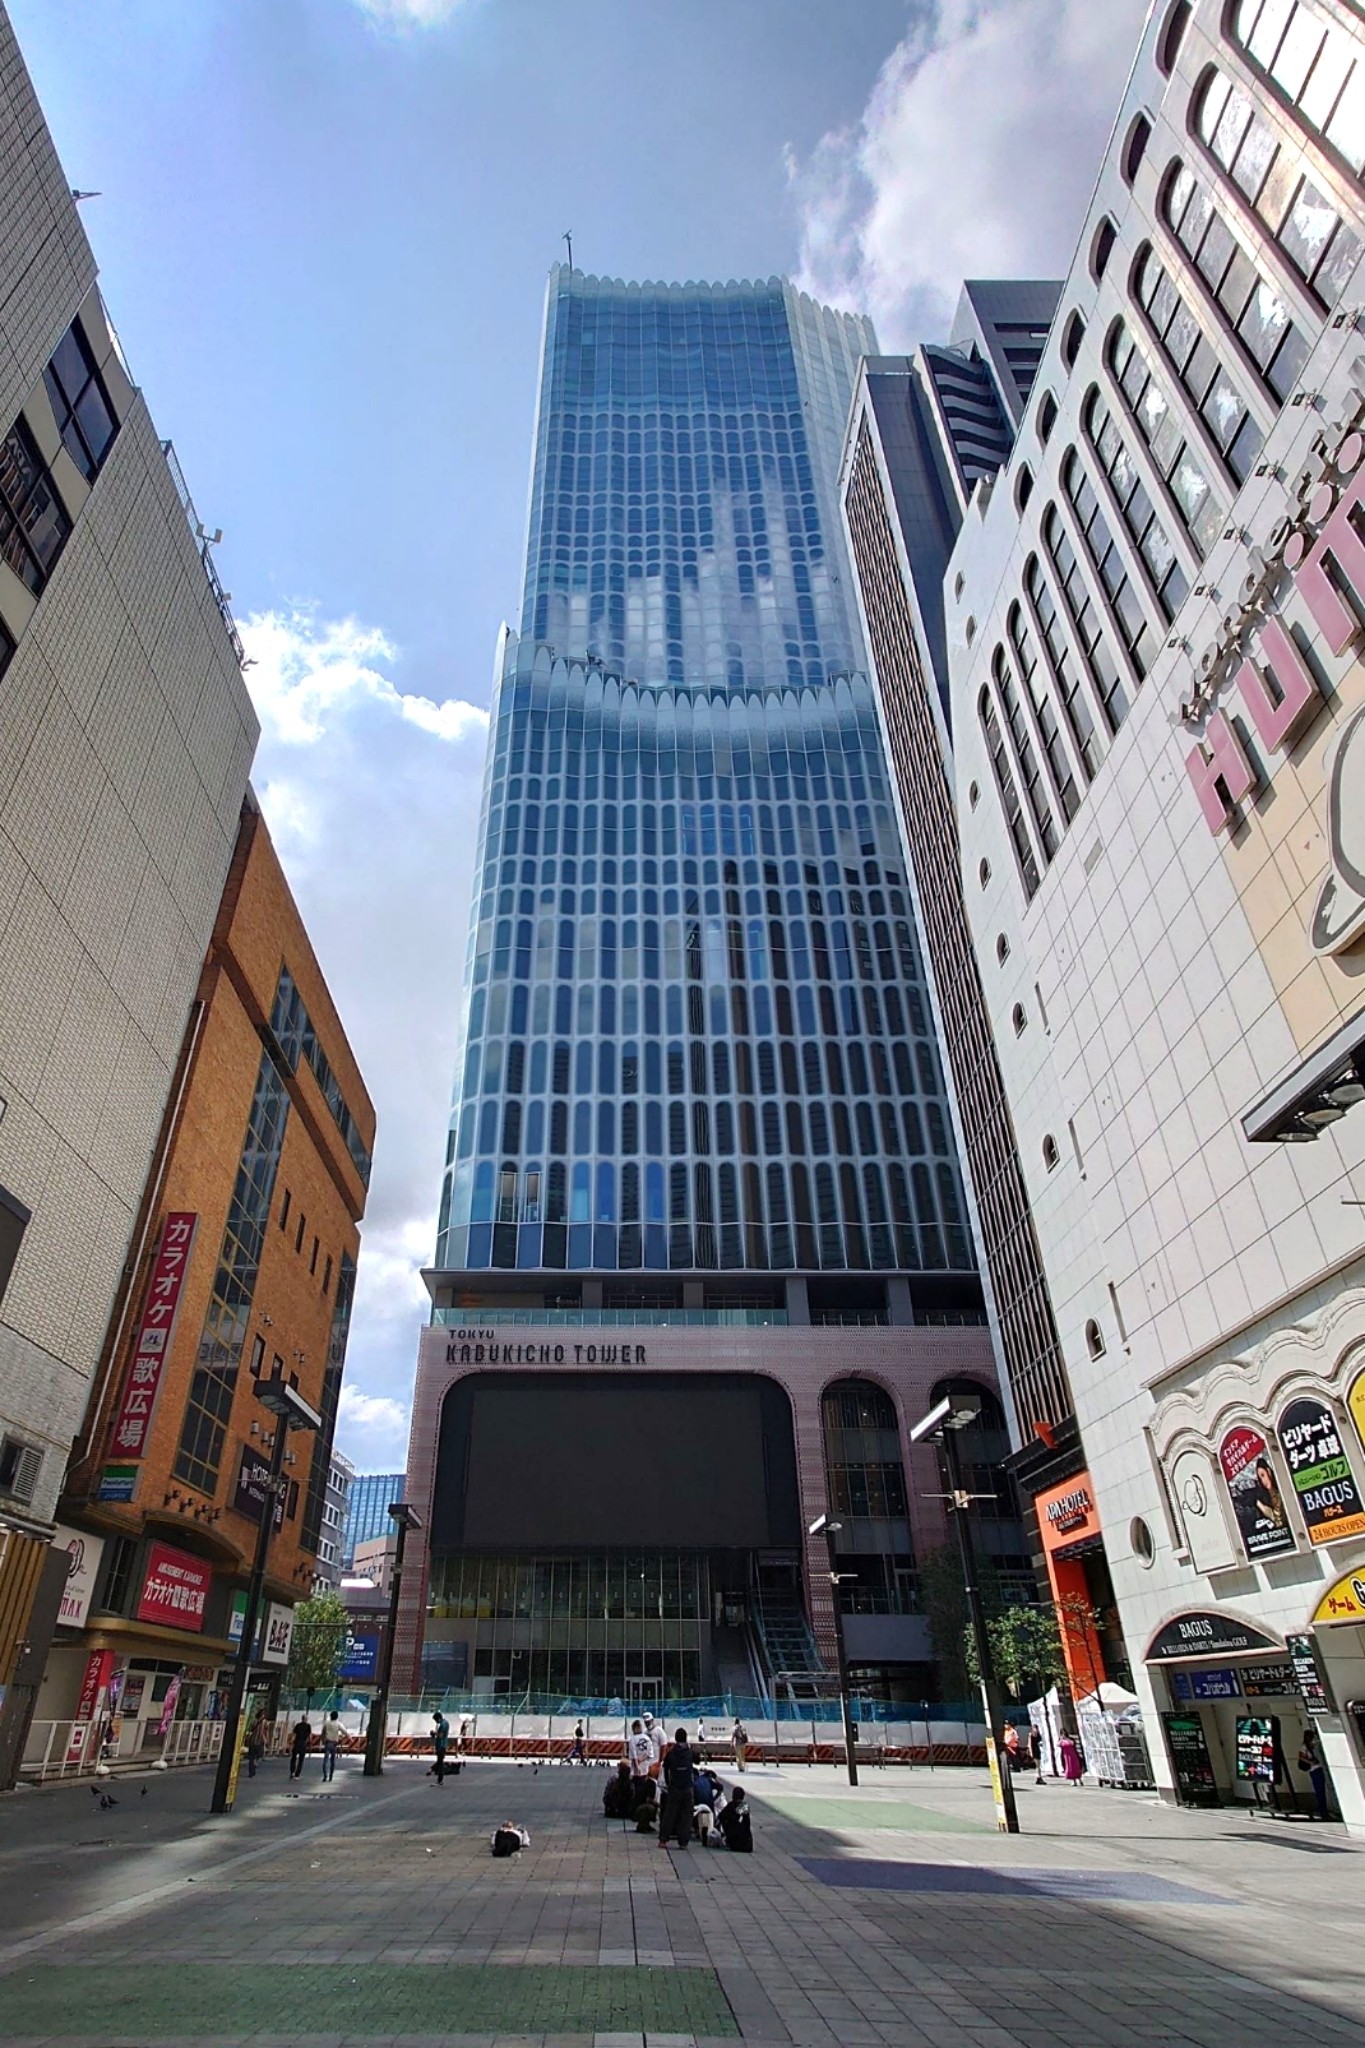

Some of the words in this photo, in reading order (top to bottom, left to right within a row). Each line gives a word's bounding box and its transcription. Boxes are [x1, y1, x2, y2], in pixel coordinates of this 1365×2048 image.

[147, 1220, 191, 1324] カラオケ
[448, 1329, 495, 1339] TOKYU
[446, 1344, 565, 1363] KABUKICHO
[574, 1344, 646, 1364] TOWER
[117, 1357, 159, 1448] 歌広場
[1282, 1413, 1332, 1450] ビリヤード
[1290, 1444, 1316, 1470] ダーツ
[1320, 1460, 1348, 1480] ゴルフ
[1060, 1489, 1088, 1512] HOTEL
[1303, 1480, 1354, 1512] BAGUS
[1268, 1526, 1289, 1541] POINT
[1313, 1529, 1323, 1540] 24
[143, 1576, 174, 1605] カラオケ
[1328, 1597, 1356, 1614] ゲーム
[1179, 1619, 1213, 1638] BAGUS
[82, 1656, 101, 1700] カラオケ
